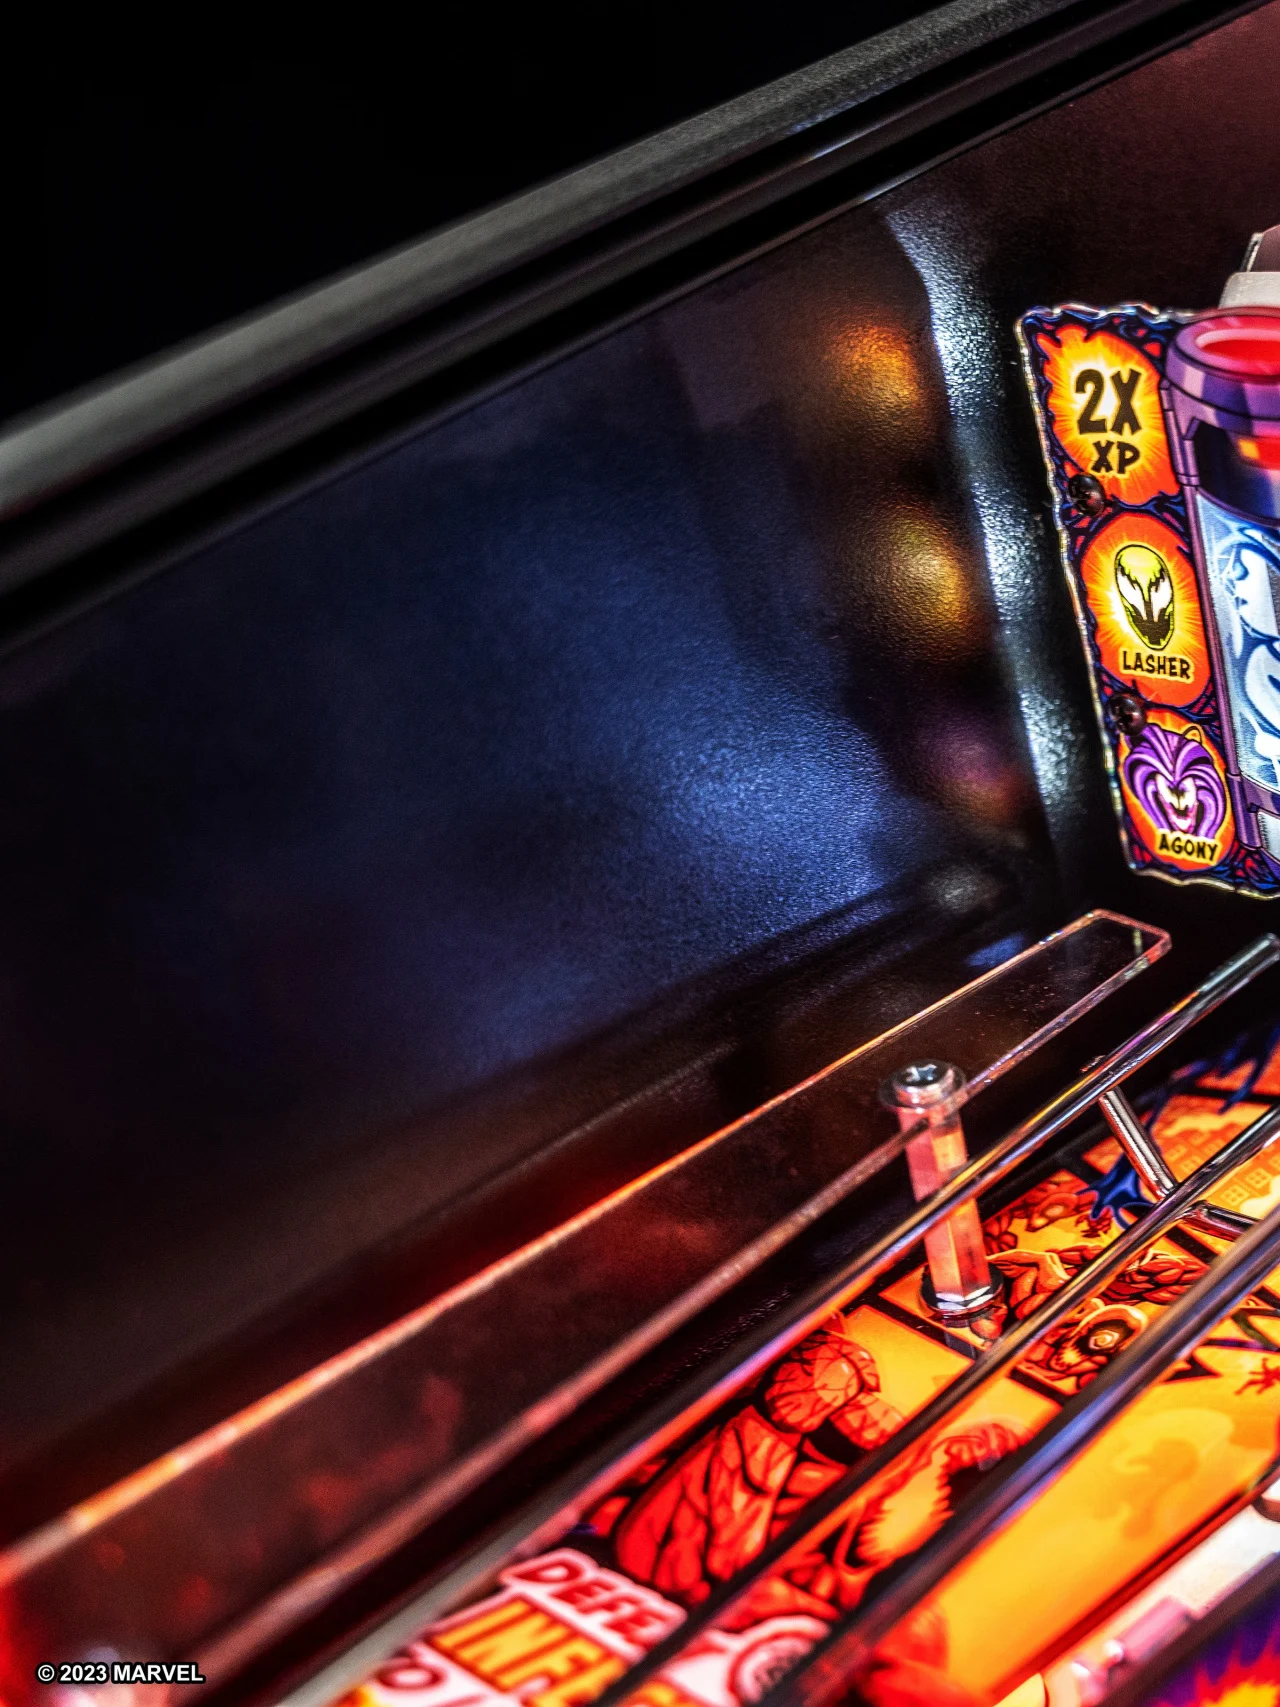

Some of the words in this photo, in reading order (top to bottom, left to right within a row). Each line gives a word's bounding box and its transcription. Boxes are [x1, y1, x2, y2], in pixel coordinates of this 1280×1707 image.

[1075, 368, 1142, 436] 2X
[1091, 440, 1141, 475] XP
[1122, 651, 1191, 679] LASHER
[1159, 834, 1218, 861] AGONY
[510, 1561, 672, 1648] DEFE
